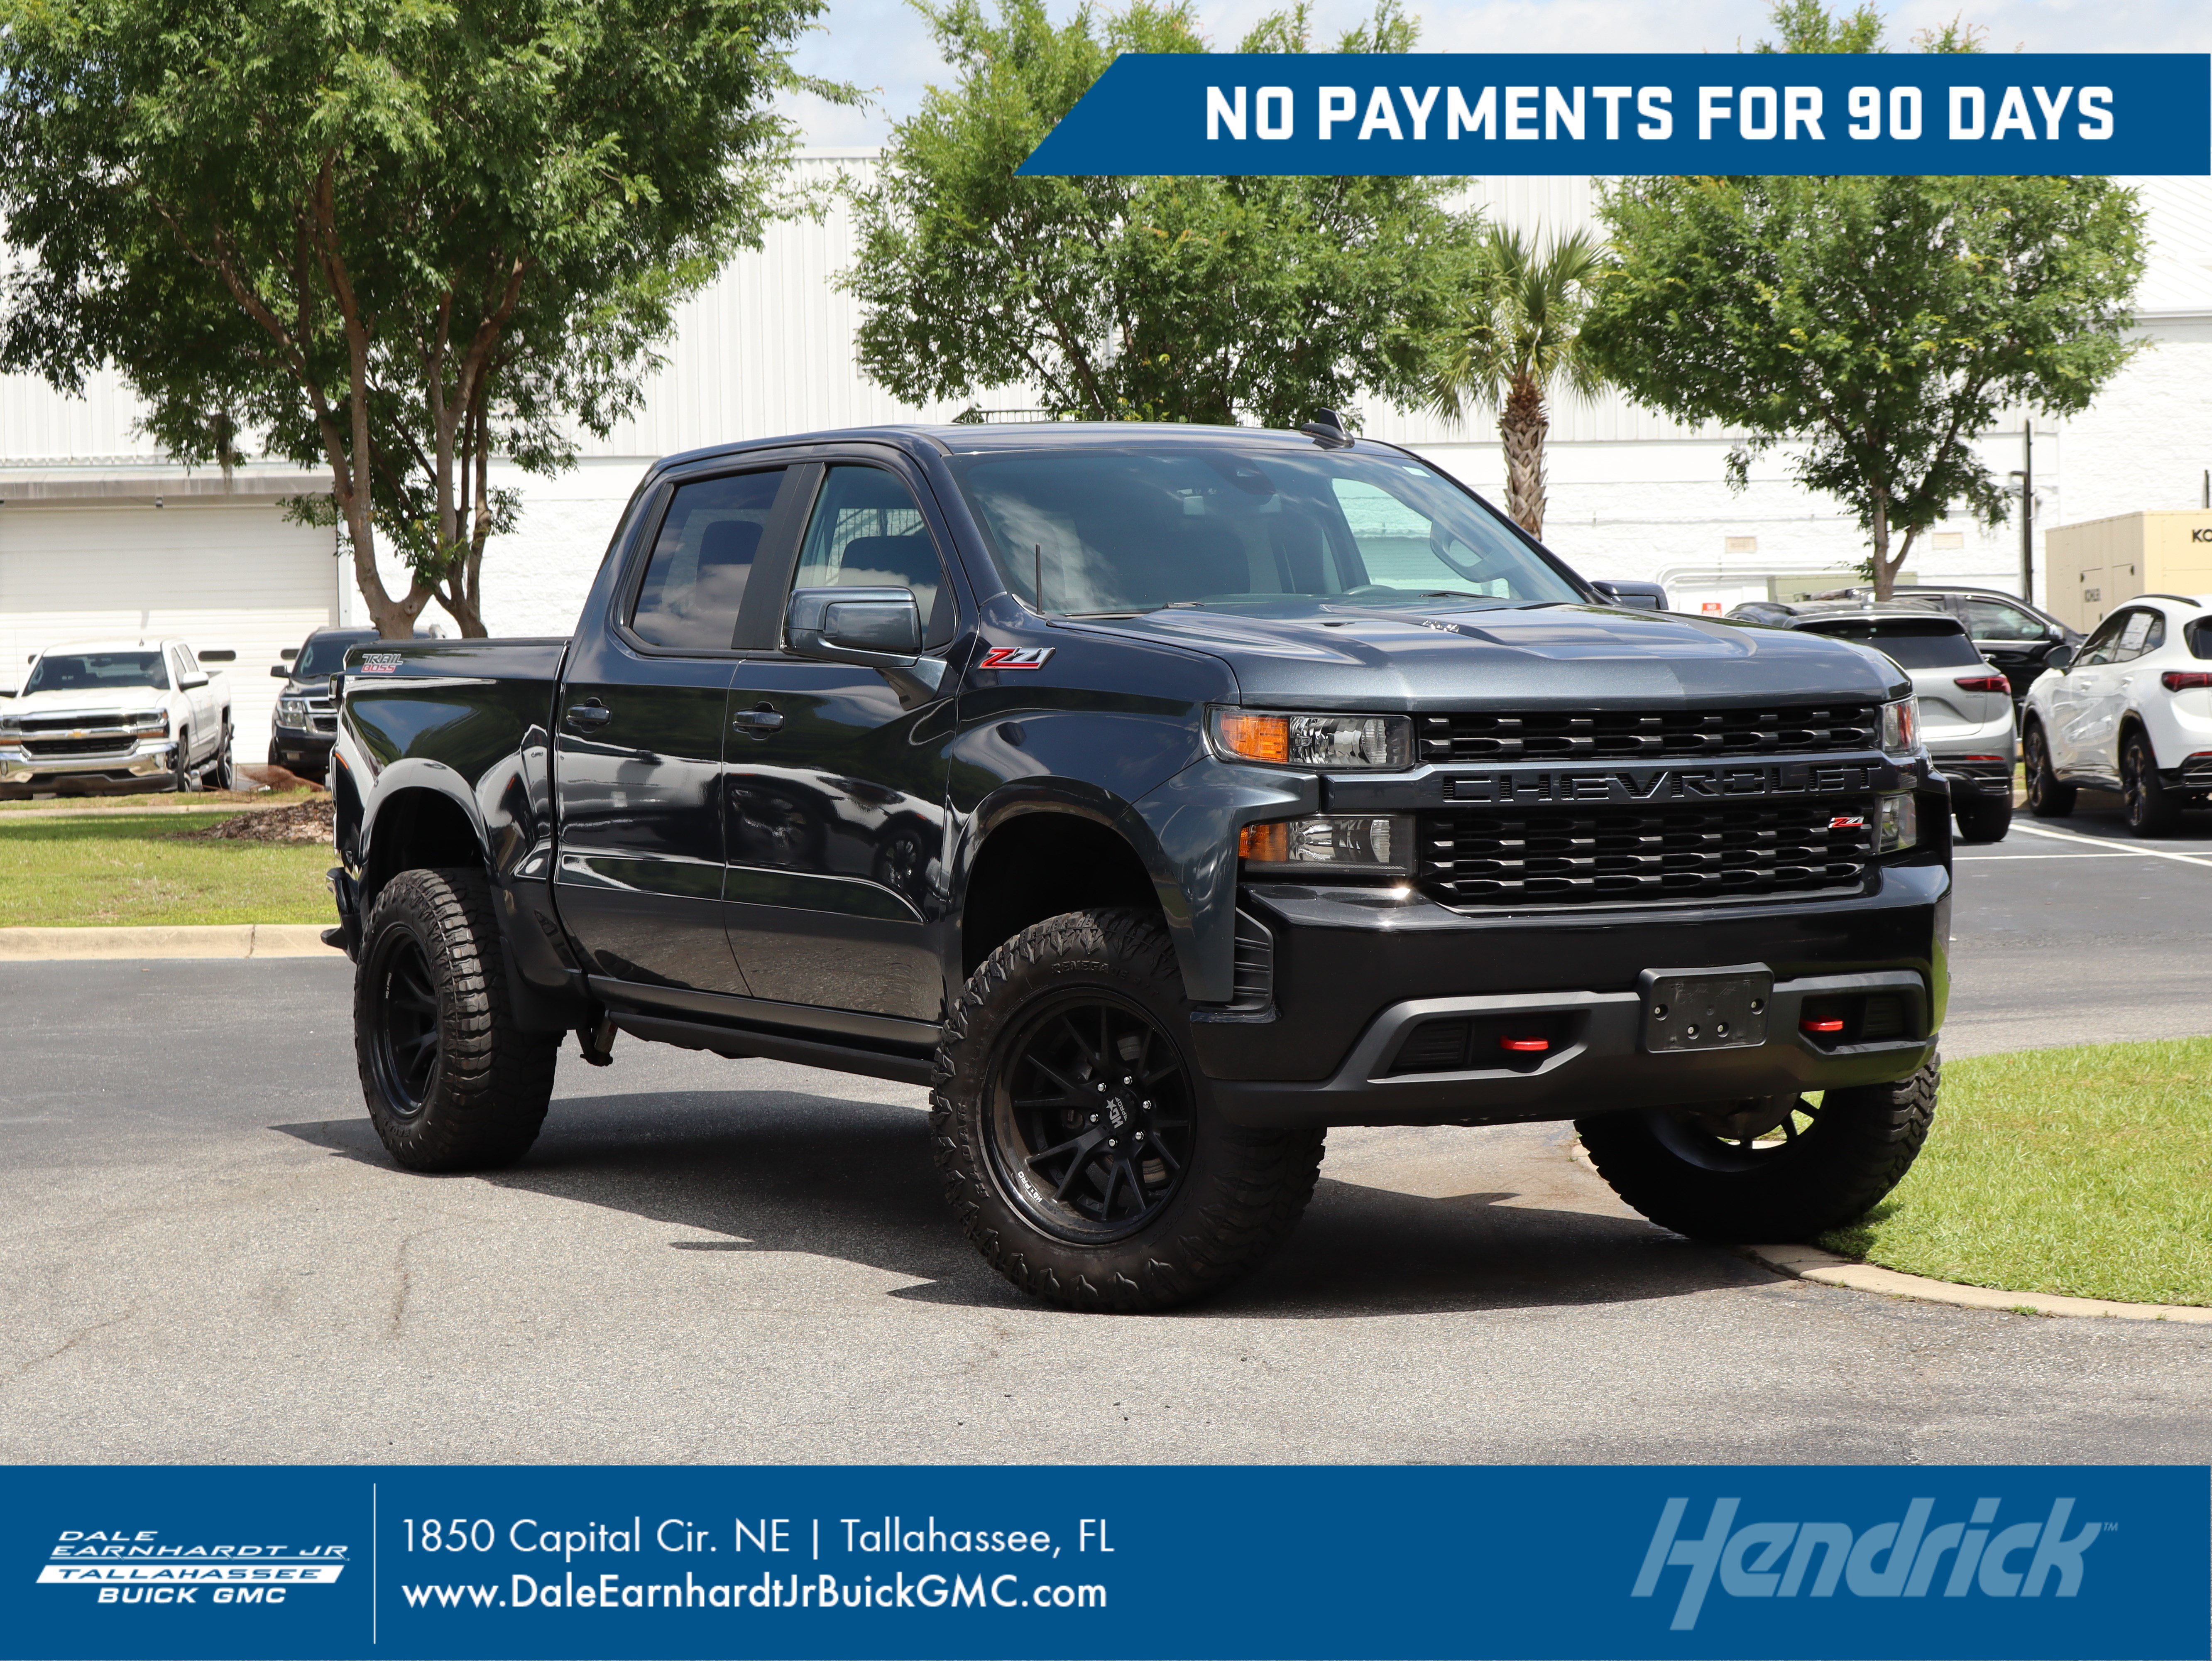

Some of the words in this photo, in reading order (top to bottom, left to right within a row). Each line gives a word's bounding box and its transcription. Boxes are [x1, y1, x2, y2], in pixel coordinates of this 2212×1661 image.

[362, 653, 404, 665] TRAIL
[361, 664, 396, 673] BOSS
[1442, 763, 1882, 803] CHEVROLET
